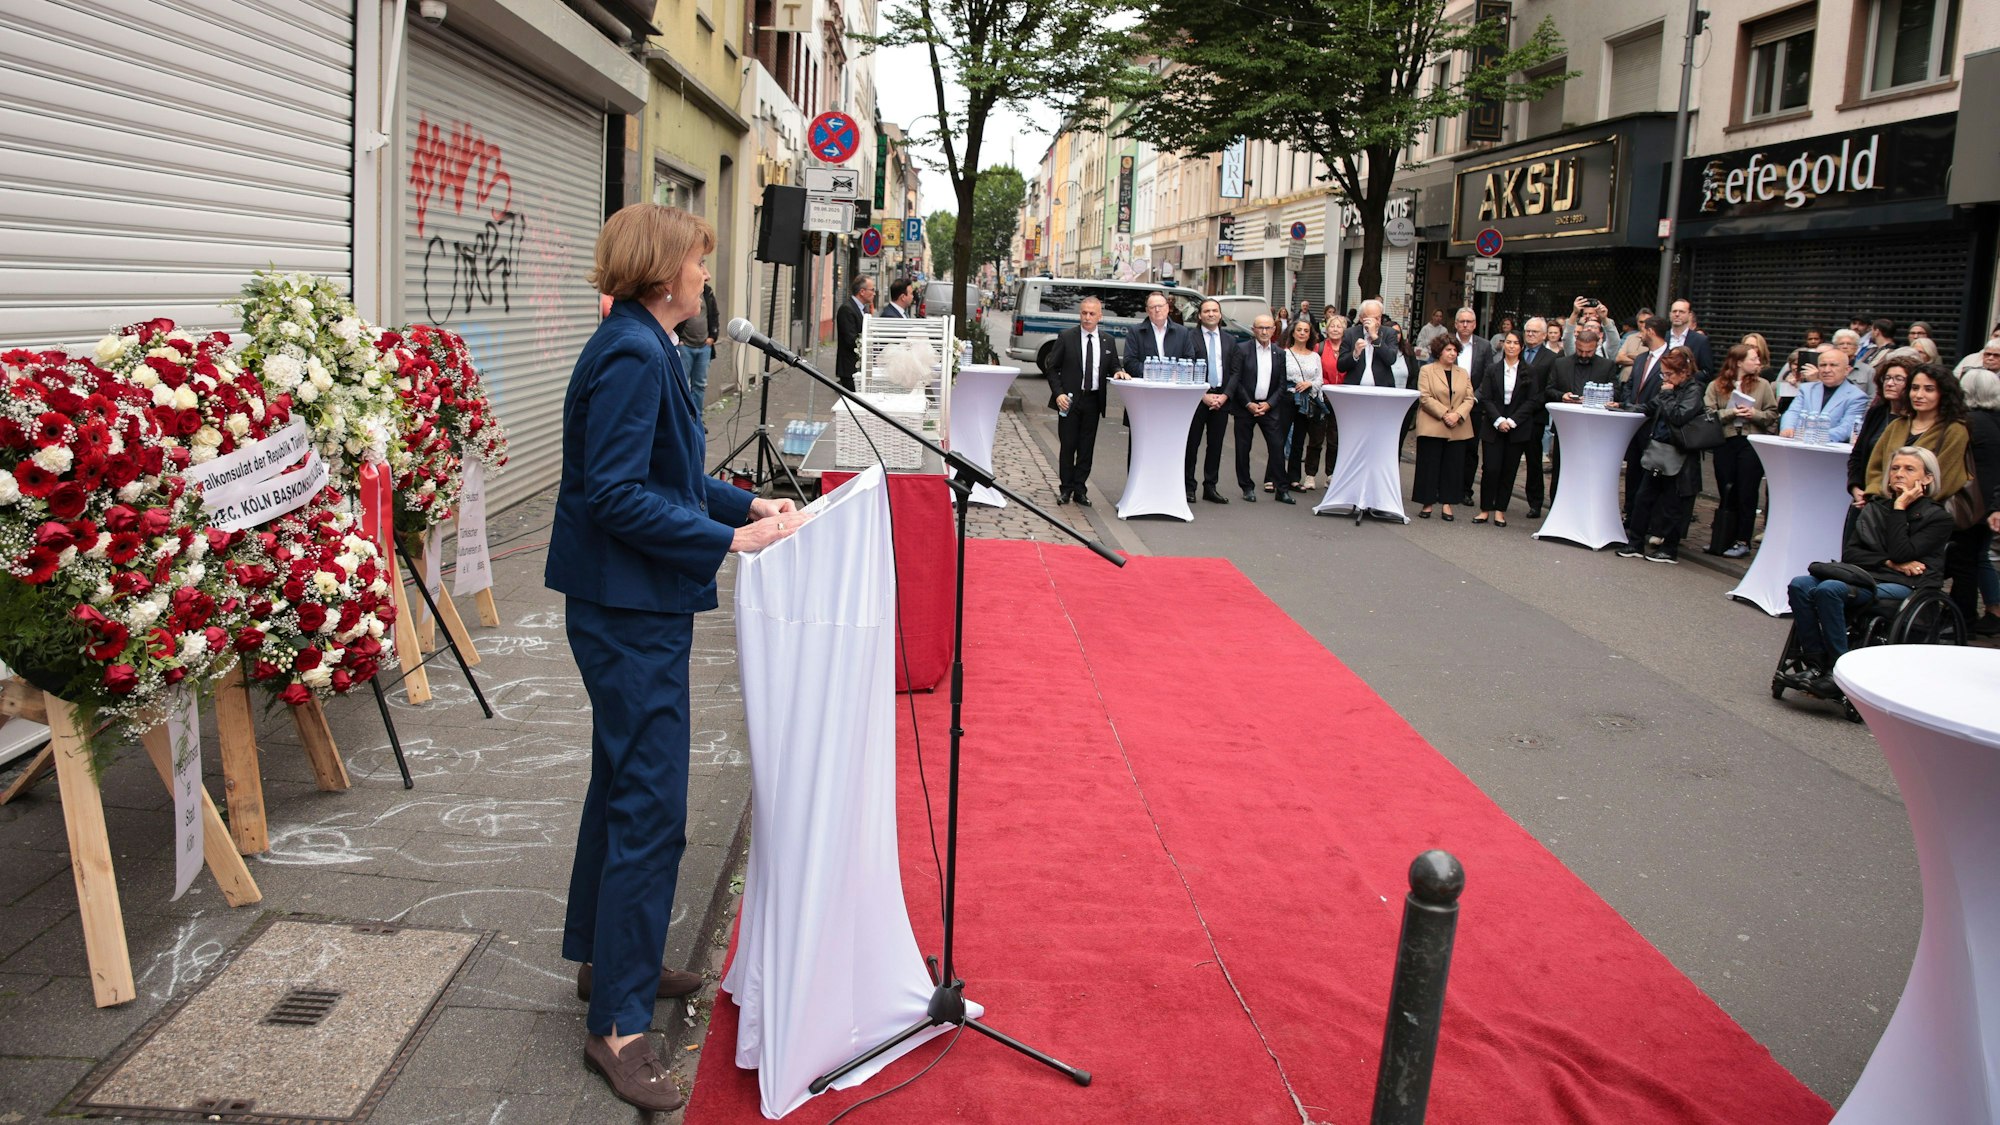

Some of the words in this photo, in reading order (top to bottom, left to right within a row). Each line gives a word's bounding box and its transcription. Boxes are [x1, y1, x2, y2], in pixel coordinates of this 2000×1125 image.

[1225, 146, 1240, 195] MRA
[1478, 157, 1577, 221] AKSU
[1725, 153, 1778, 204] efe
[1784, 134, 1879, 208] gold
[1113, 326, 1129, 334] PO
[202, 461, 253, 493] ralkonsulat
[253, 455, 267, 471] der
[265, 442, 292, 466] Republik
[240, 494, 272, 517] KÖLN
